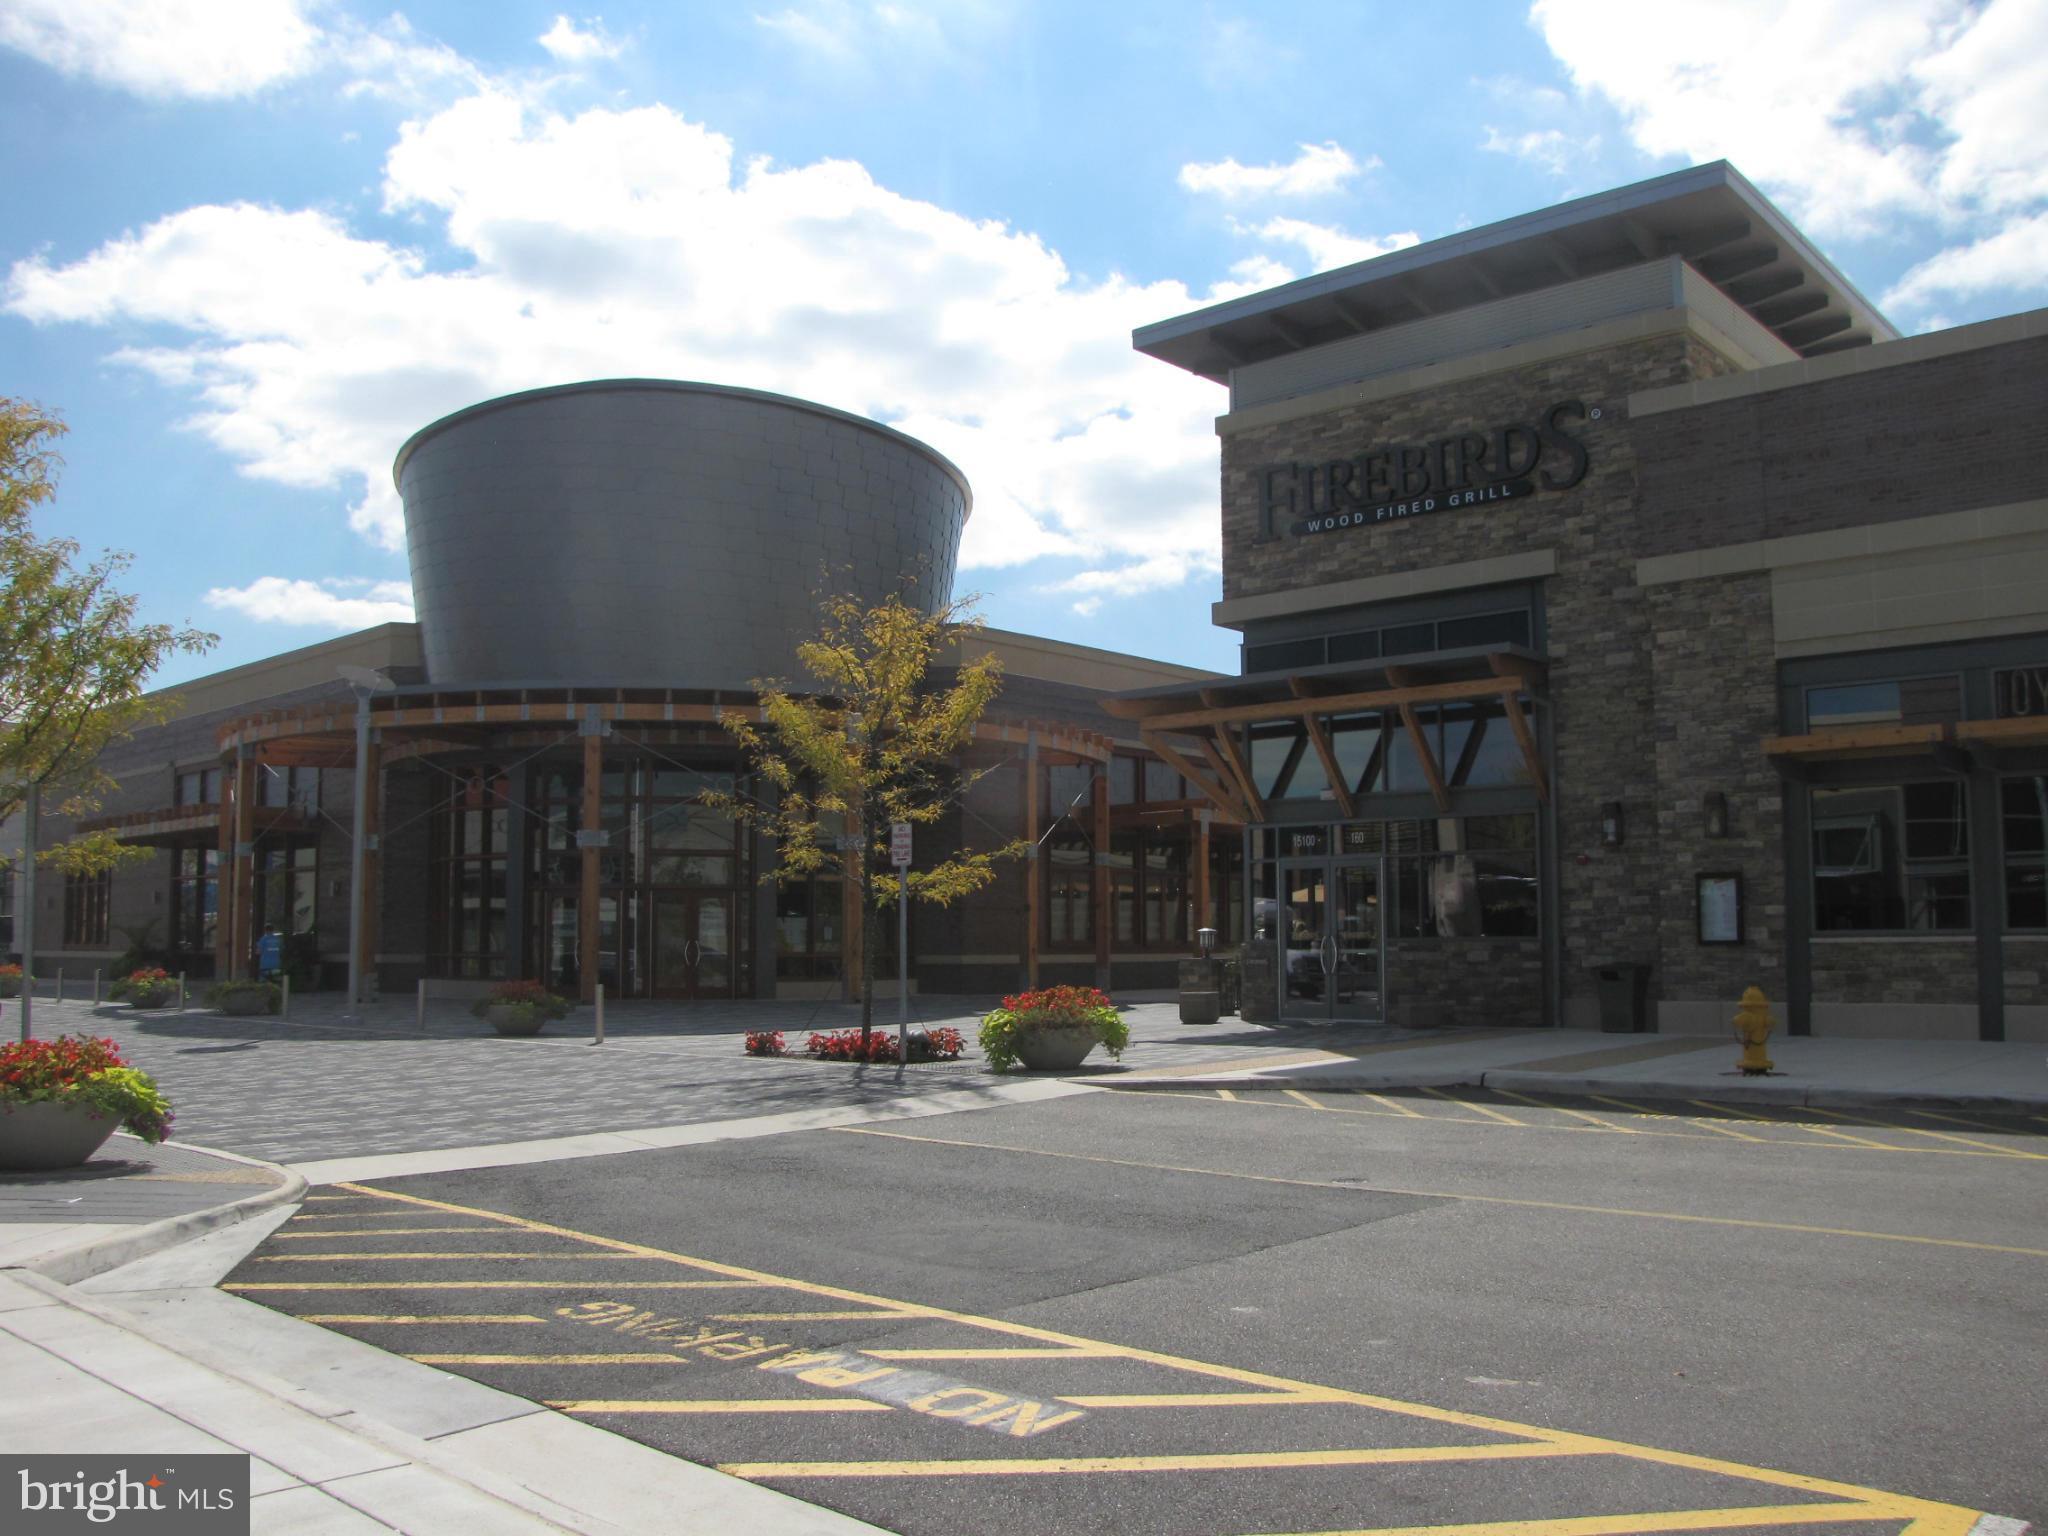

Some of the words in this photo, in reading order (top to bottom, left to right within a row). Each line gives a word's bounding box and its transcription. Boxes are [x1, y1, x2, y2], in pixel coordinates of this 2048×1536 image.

[1307, 511, 1364, 533] WOOD
[1376, 499, 1435, 521] FIRED
[1449, 484, 1511, 507] GRILL
[556, 1300, 901, 1388] PARKING
[907, 1387, 1086, 1437] NO
